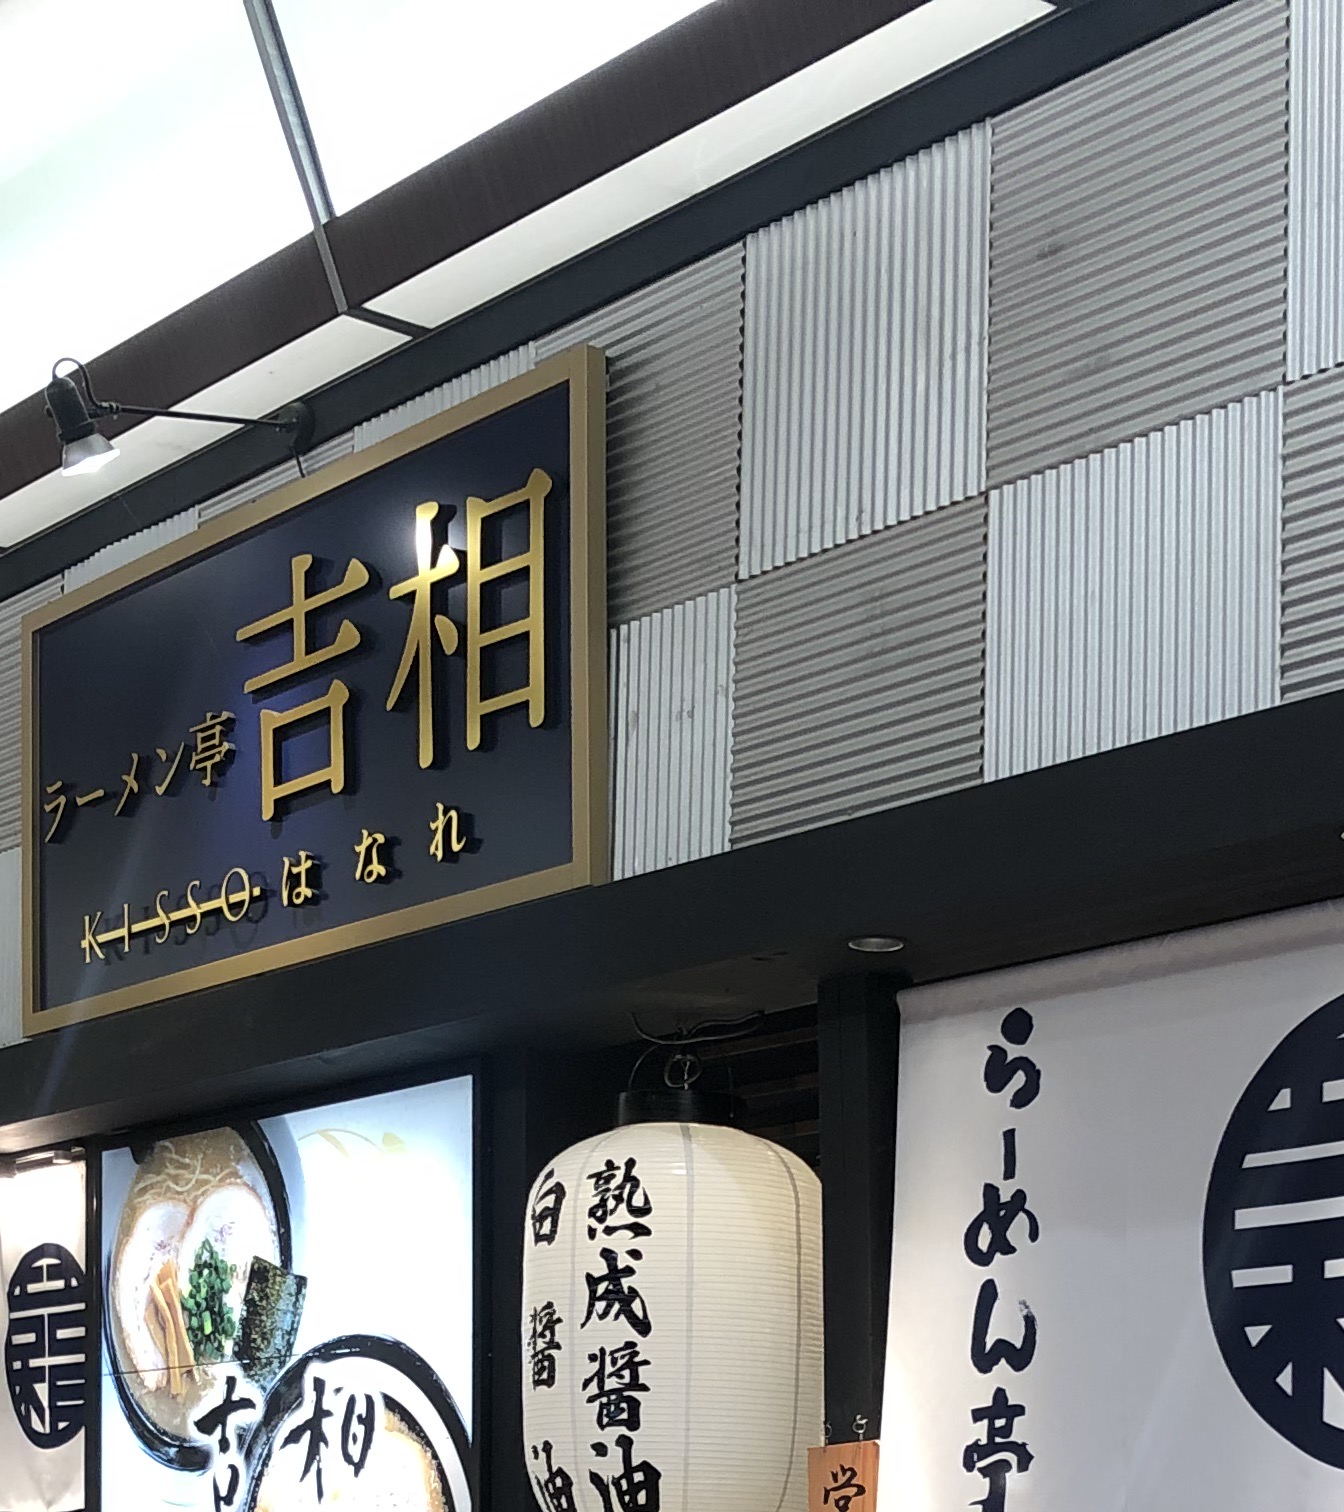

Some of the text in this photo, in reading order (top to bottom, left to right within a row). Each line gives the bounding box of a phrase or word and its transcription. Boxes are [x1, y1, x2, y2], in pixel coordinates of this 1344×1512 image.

[235, 467, 554, 823] 吉相
[43, 710, 236, 844] ラーメン亭
[282, 803, 466, 909] はなれ
